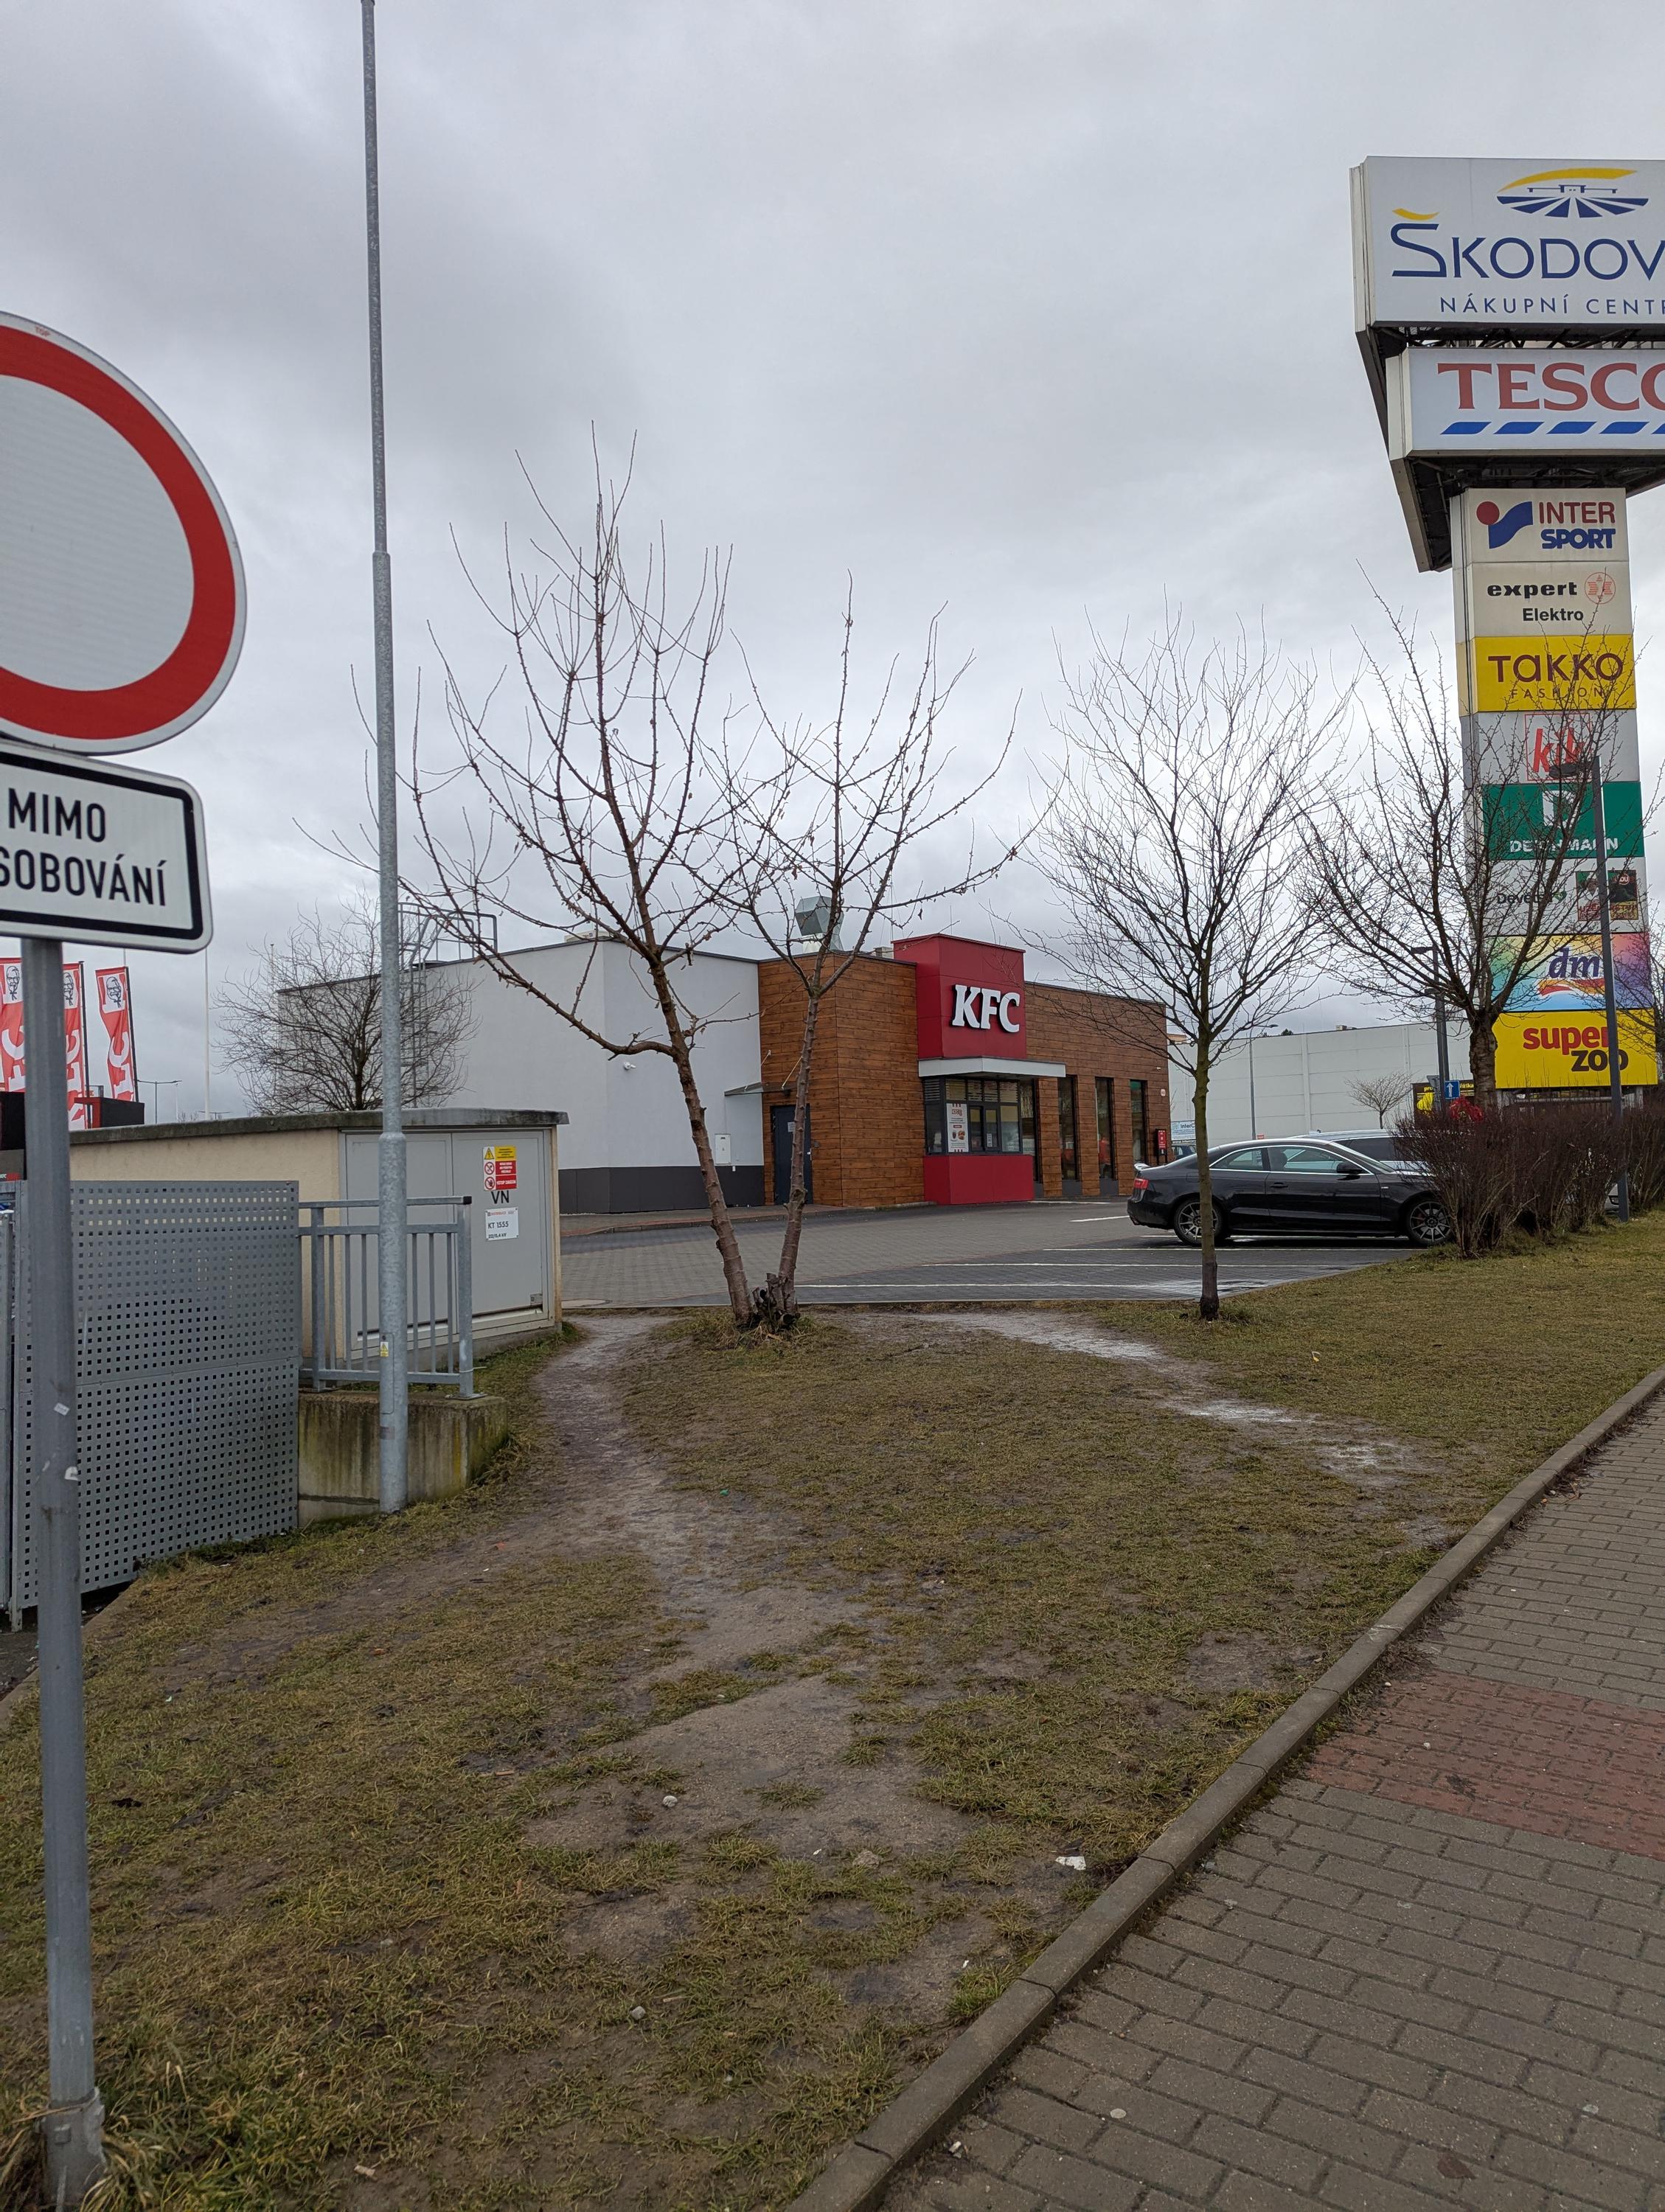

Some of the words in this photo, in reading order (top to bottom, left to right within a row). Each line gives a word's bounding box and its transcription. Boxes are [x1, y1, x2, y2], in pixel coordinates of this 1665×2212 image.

[1440, 293, 1568, 314] NÁKUPNÍ
[1586, 298, 1665, 316] CENT
[1539, 501, 1616, 524] INTER
[1540, 528, 1616, 549] SPORT
[1487, 582, 1578, 599] expert
[1522, 608, 1584, 622] Elektro
[8, 787, 105, 843] MIMO
[1509, 838, 1619, 852] DEHMAN
[1548, 947, 1600, 979] dm
[952, 984, 1021, 1033] KFC
[1571, 1048, 1629, 1072] zoo
[491, 1190, 510, 1205] VN
[496, 1220, 509, 1228] 1555
